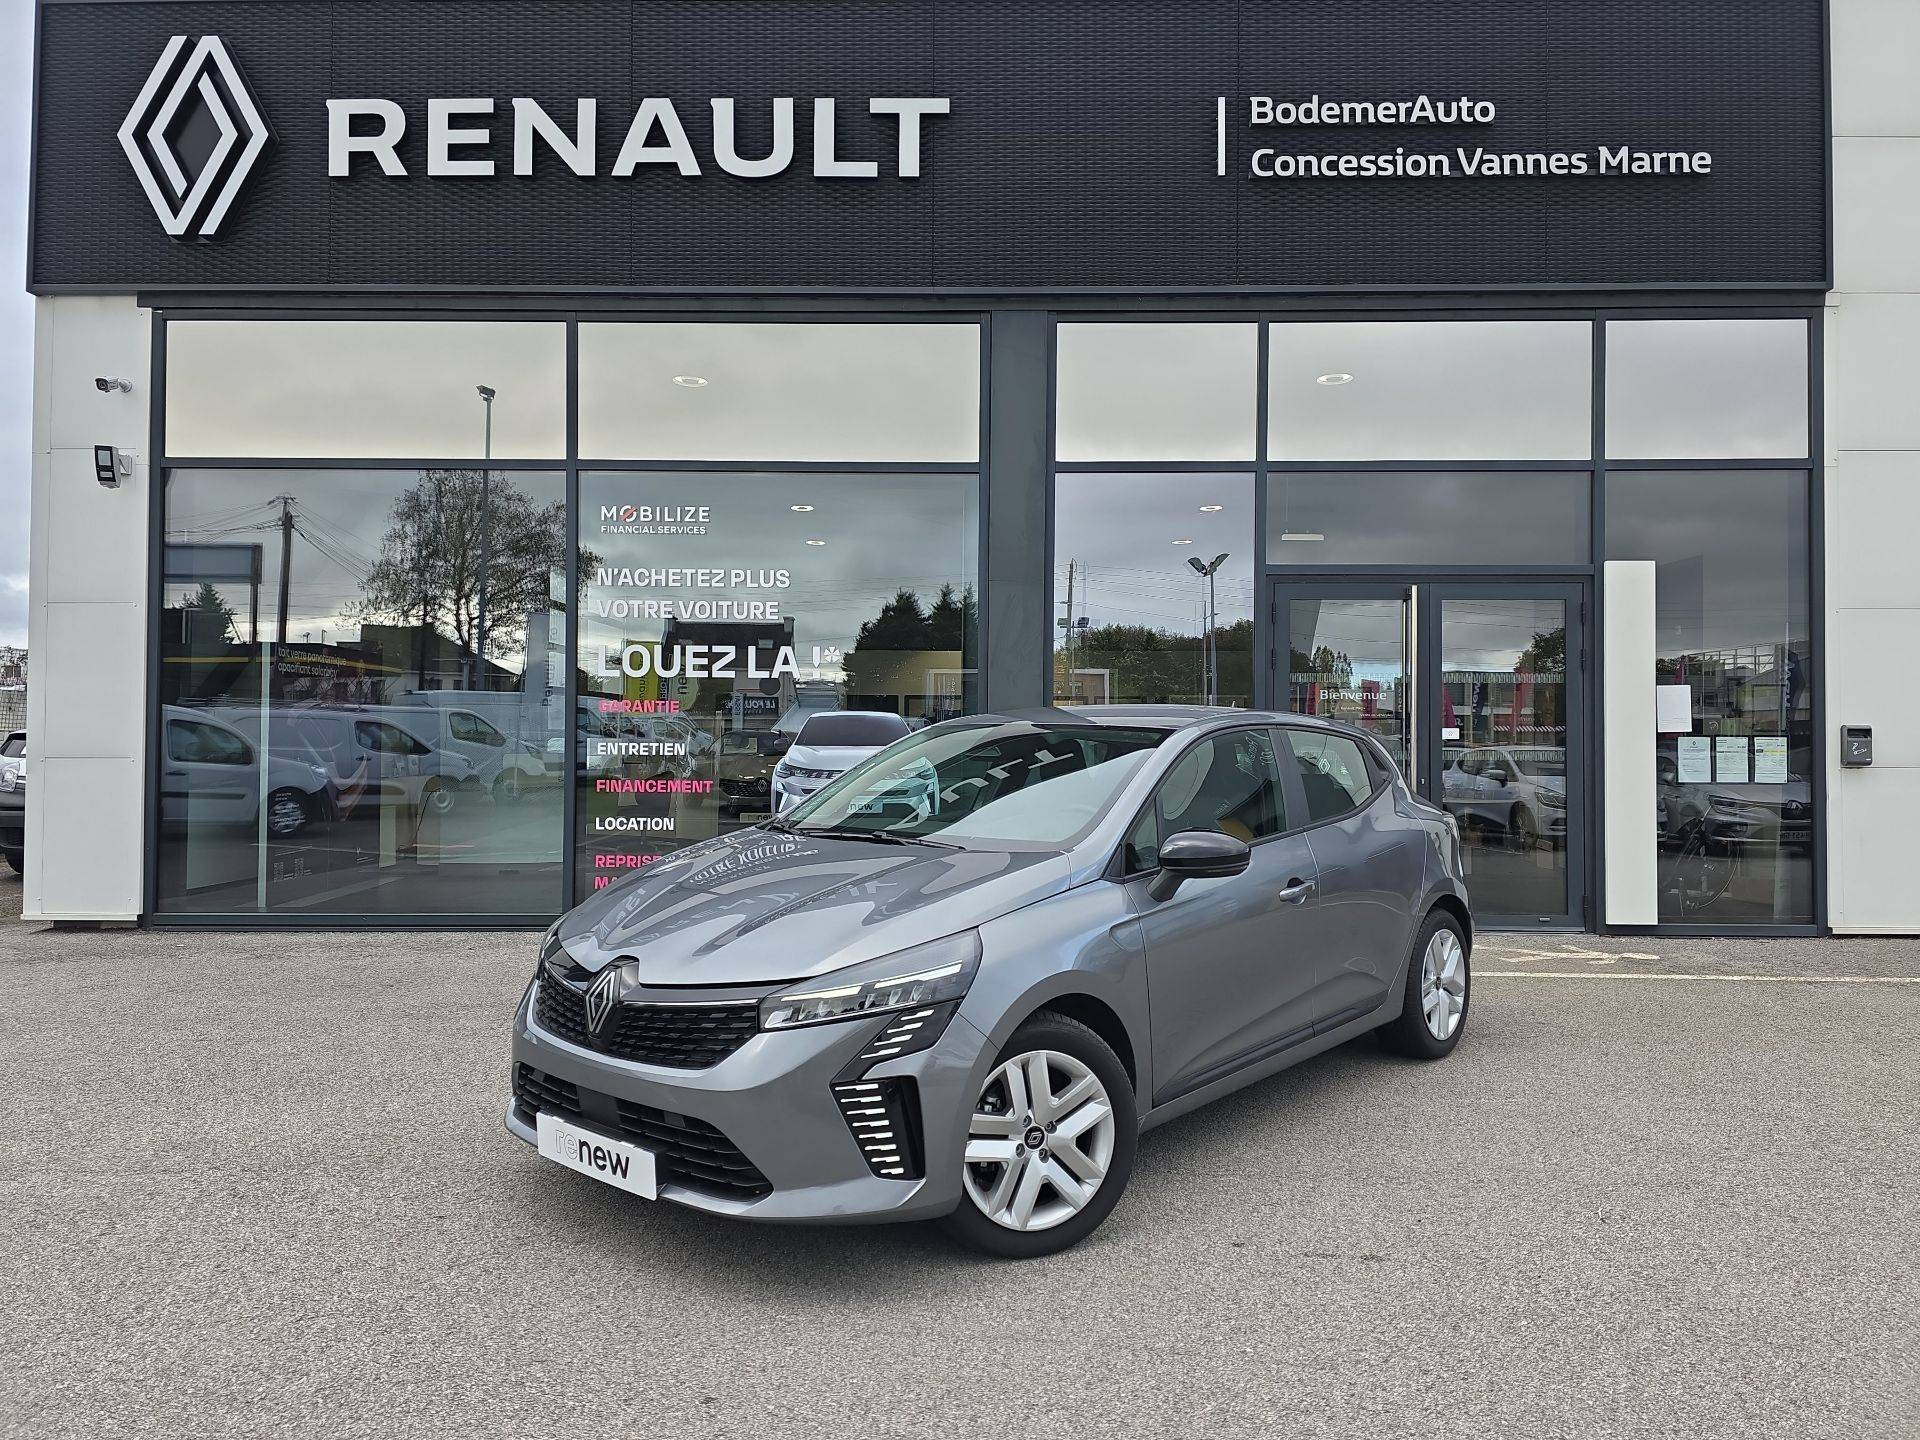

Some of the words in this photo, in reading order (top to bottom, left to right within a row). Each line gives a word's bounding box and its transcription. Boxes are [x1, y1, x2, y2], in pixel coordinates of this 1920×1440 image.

[1250, 95, 1496, 124] BodemerAuto
[326, 97, 950, 177] RENAULT
[1251, 147, 1451, 177] Concession
[1457, 148, 1588, 176] Vannes
[1599, 145, 1712, 174] Marne
[601, 505, 710, 522] MOBILIZE
[601, 525, 656, 534] FINANCIAL
[657, 525, 706, 535] SERVICES
[598, 567, 725, 587] N'ACHETEZ
[731, 569, 790, 588] PLUS
[599, 600, 674, 618] VOTRE
[679, 601, 779, 620] VOITURE
[598, 645, 735, 678] LOUEZ
[748, 646, 801, 679] LA
[1320, 689, 1387, 700] Bienvenue
[598, 700, 680, 714] GARANTIE
[597, 742, 685, 756] ENTRETIEN
[595, 780, 714, 793] FINANCEMENT
[595, 817, 675, 831] LOCATION
[554, 1129, 630, 1179] renew
